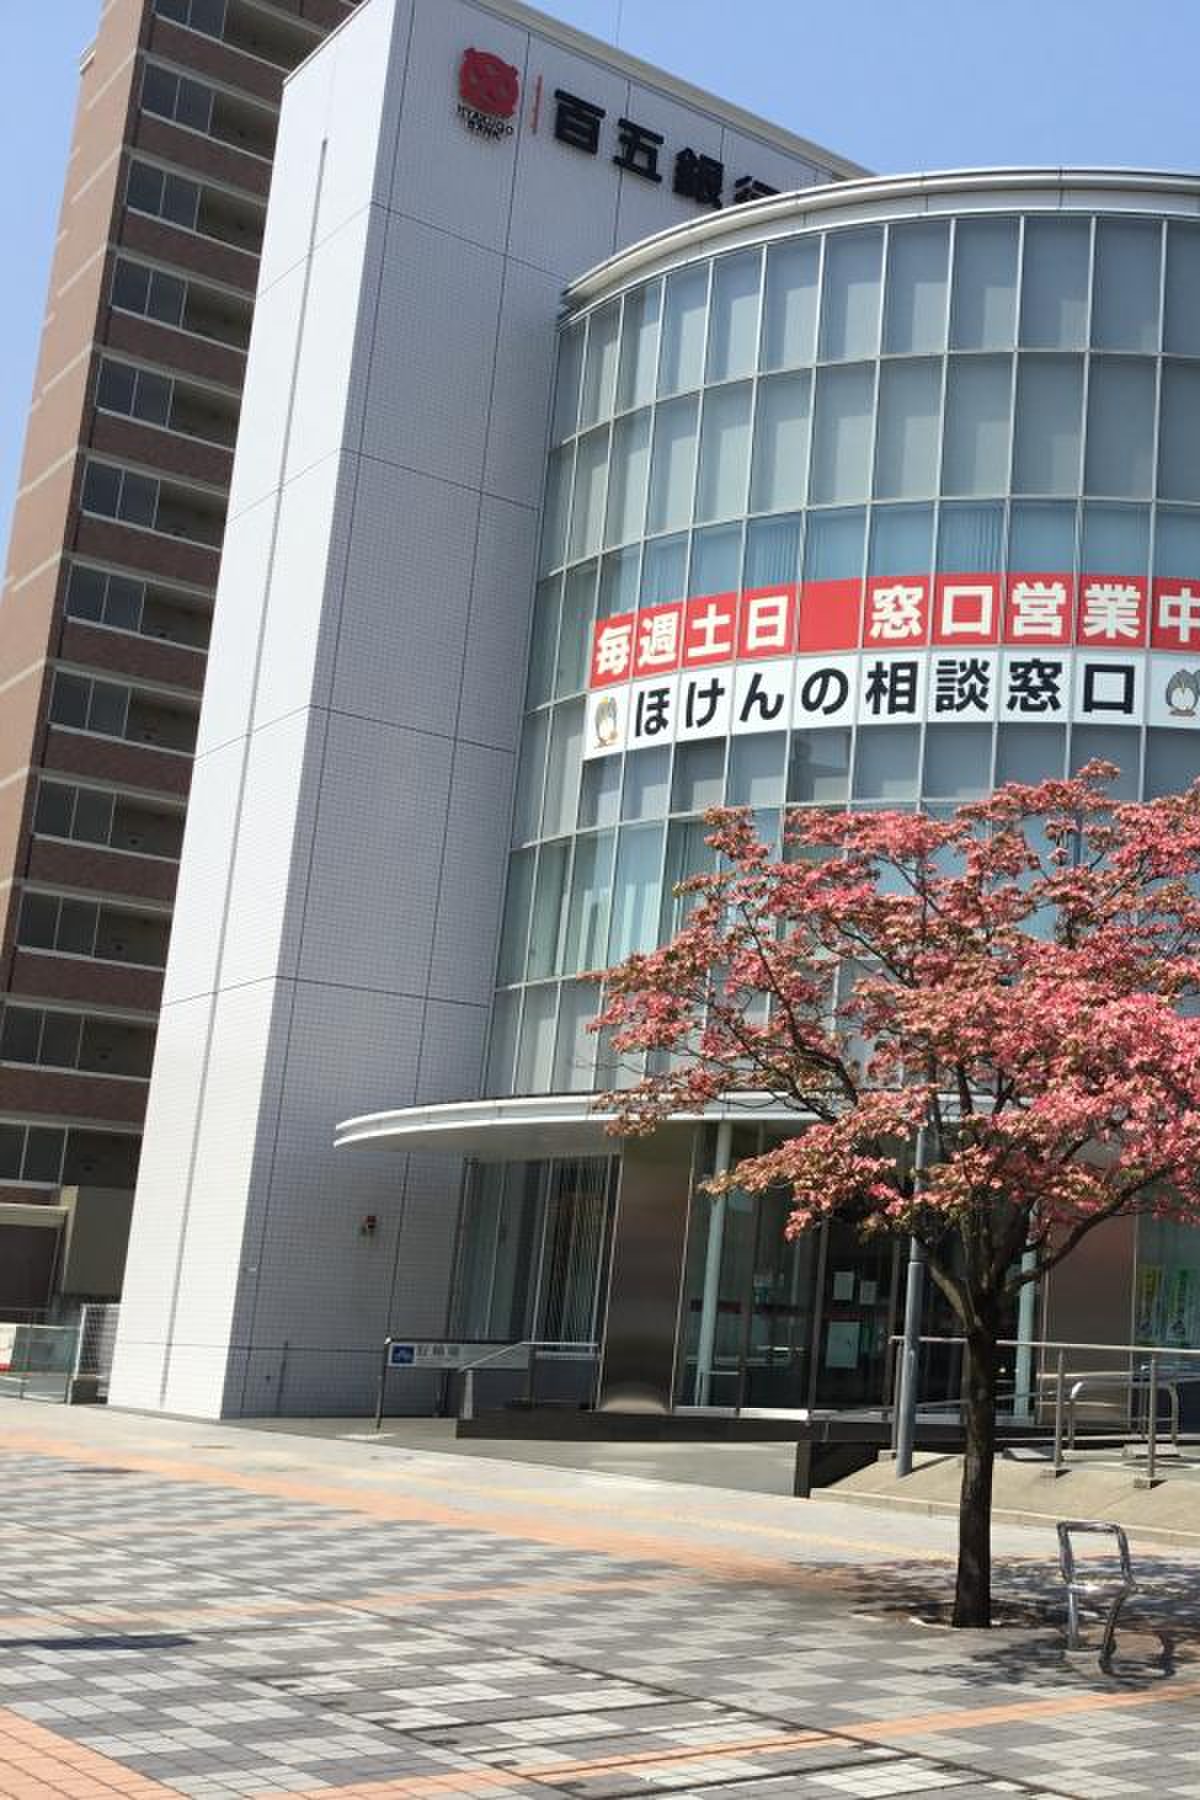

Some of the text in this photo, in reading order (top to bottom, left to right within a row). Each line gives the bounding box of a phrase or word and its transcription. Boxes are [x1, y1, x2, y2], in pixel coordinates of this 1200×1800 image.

[596, 594, 789, 673] 毎週土日
[635, 658, 1136, 737] ほけんの相談窓口
